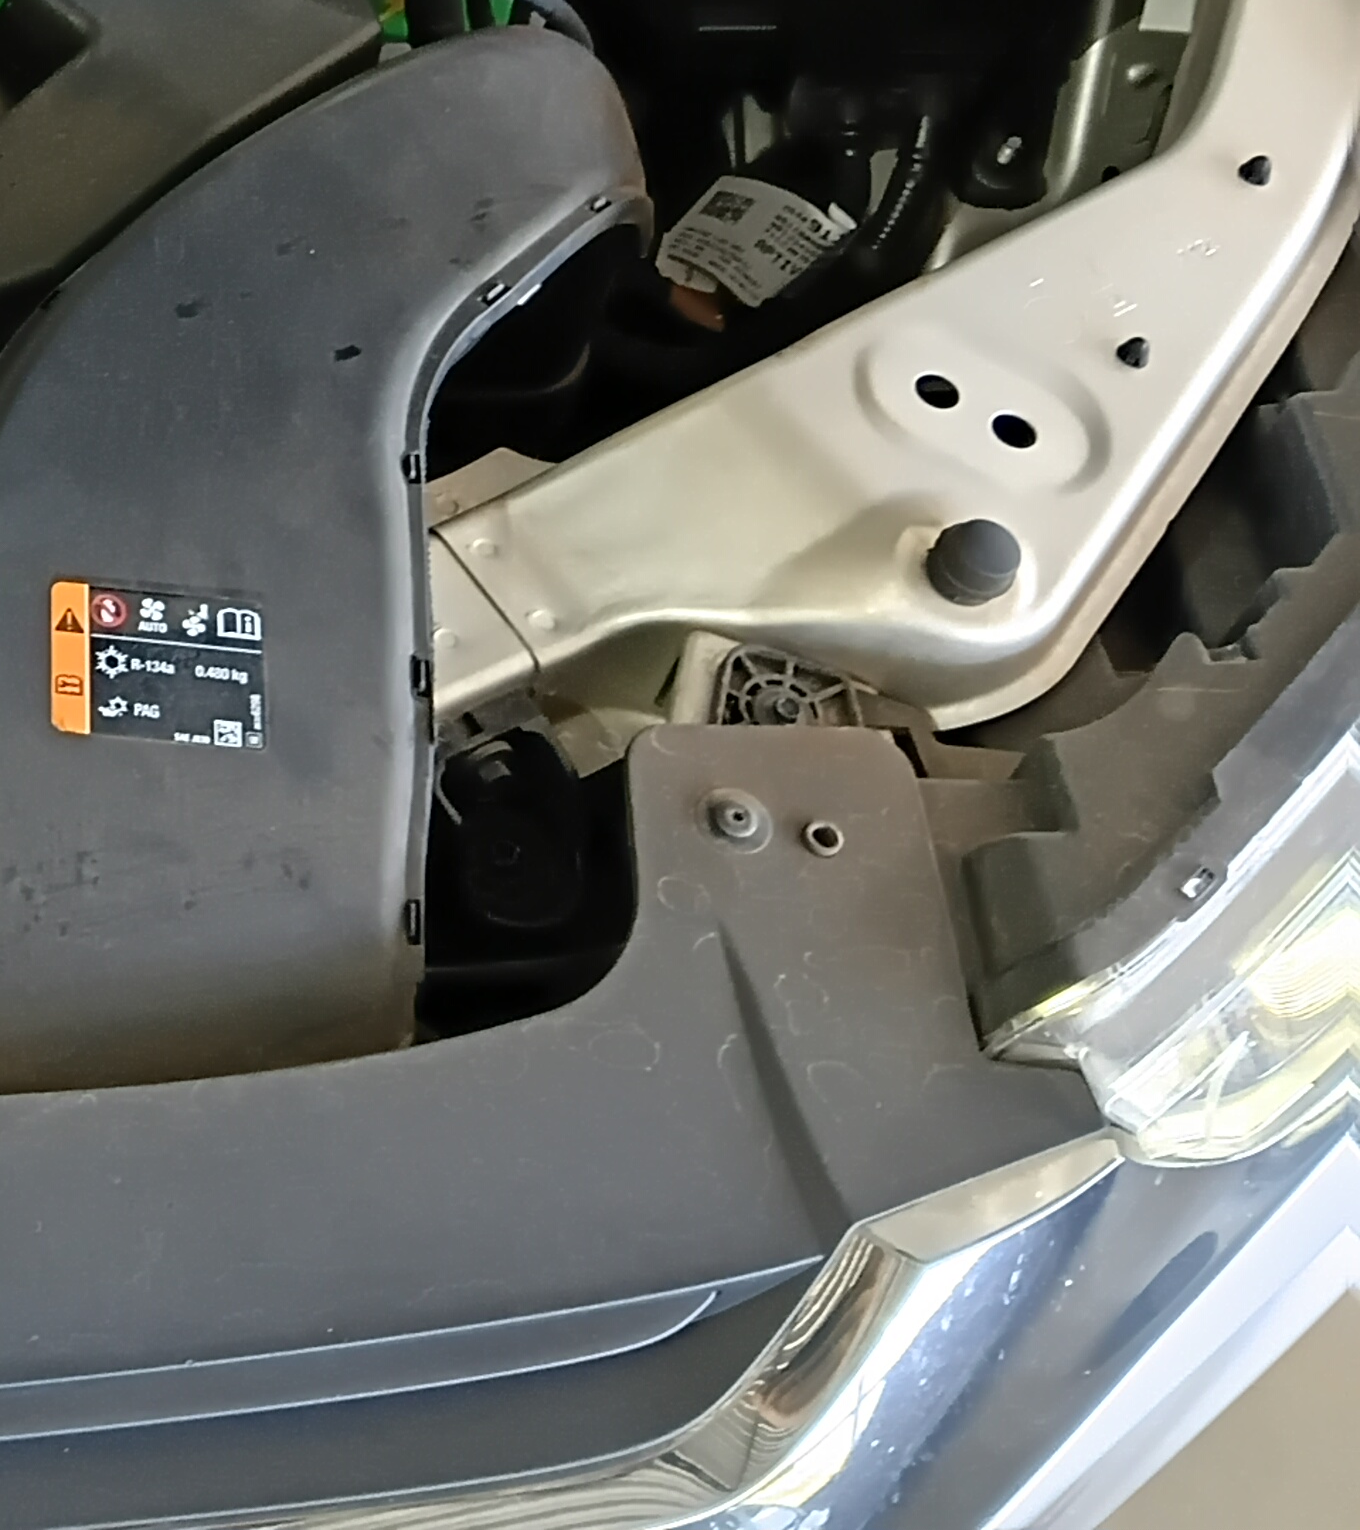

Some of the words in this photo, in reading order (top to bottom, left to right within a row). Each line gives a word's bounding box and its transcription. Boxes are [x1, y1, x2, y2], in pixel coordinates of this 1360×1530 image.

[138, 620, 168, 634] AUTO
[130, 657, 176, 675] R-134a
[133, 702, 161, 719] PAG
